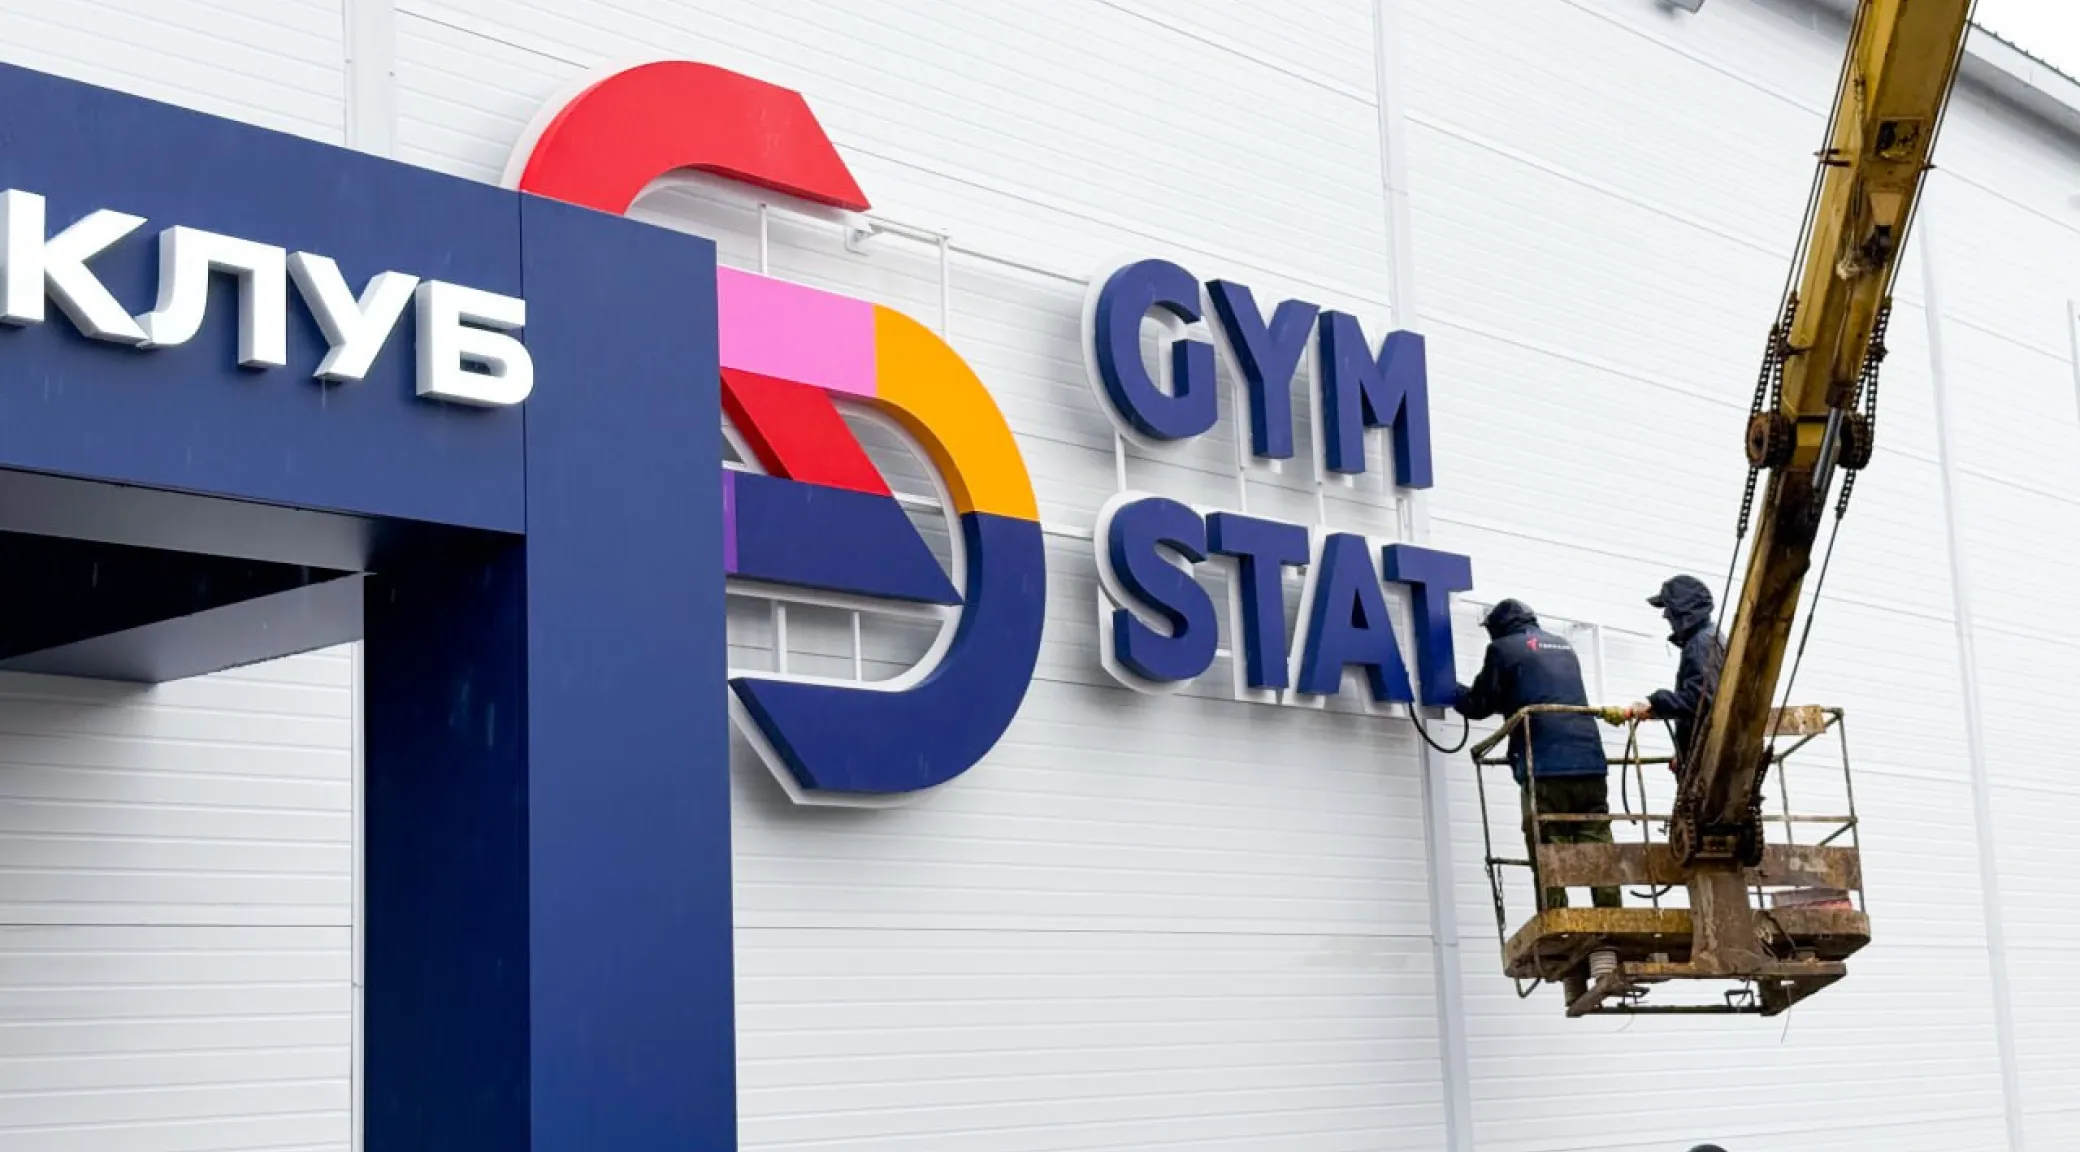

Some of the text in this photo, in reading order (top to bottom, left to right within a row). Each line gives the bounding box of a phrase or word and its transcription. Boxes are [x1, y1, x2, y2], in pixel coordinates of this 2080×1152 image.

[0, 188, 533, 405] КЛУБ
[1094, 258, 1433, 490] GYM
[1108, 497, 1473, 707] STAT
